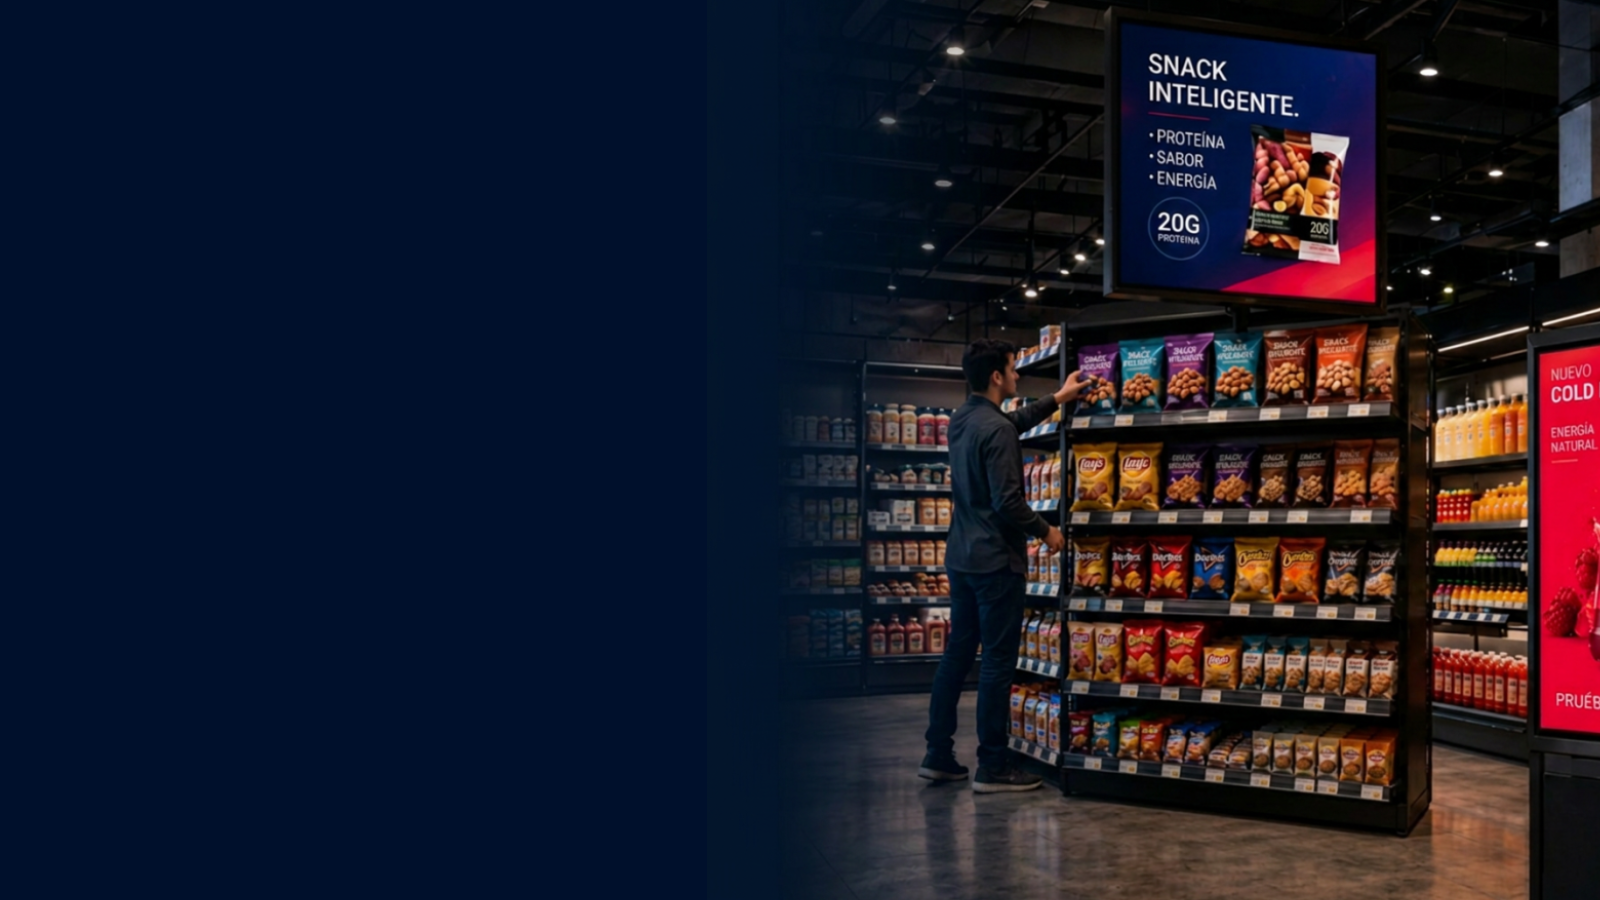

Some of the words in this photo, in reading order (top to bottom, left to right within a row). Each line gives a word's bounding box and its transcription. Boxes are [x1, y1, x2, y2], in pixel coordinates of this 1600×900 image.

[1148, 53, 1228, 82] SNACK
[1148, 80, 1300, 118] INTELIGENTE.
[1157, 128, 1226, 150] PROTEÍNA
[1156, 150, 1205, 168] SABOR
[1157, 170, 1218, 190] ENERGÍA
[1157, 212, 1200, 234] 20G
[1551, 363, 1592, 381] NUEVO
[1551, 382, 1594, 403] COLD
[1551, 421, 1595, 439] ENERGÍA
[1551, 438, 1598, 453] NATURAL
[1555, 691, 1600, 710] PRUÉB
